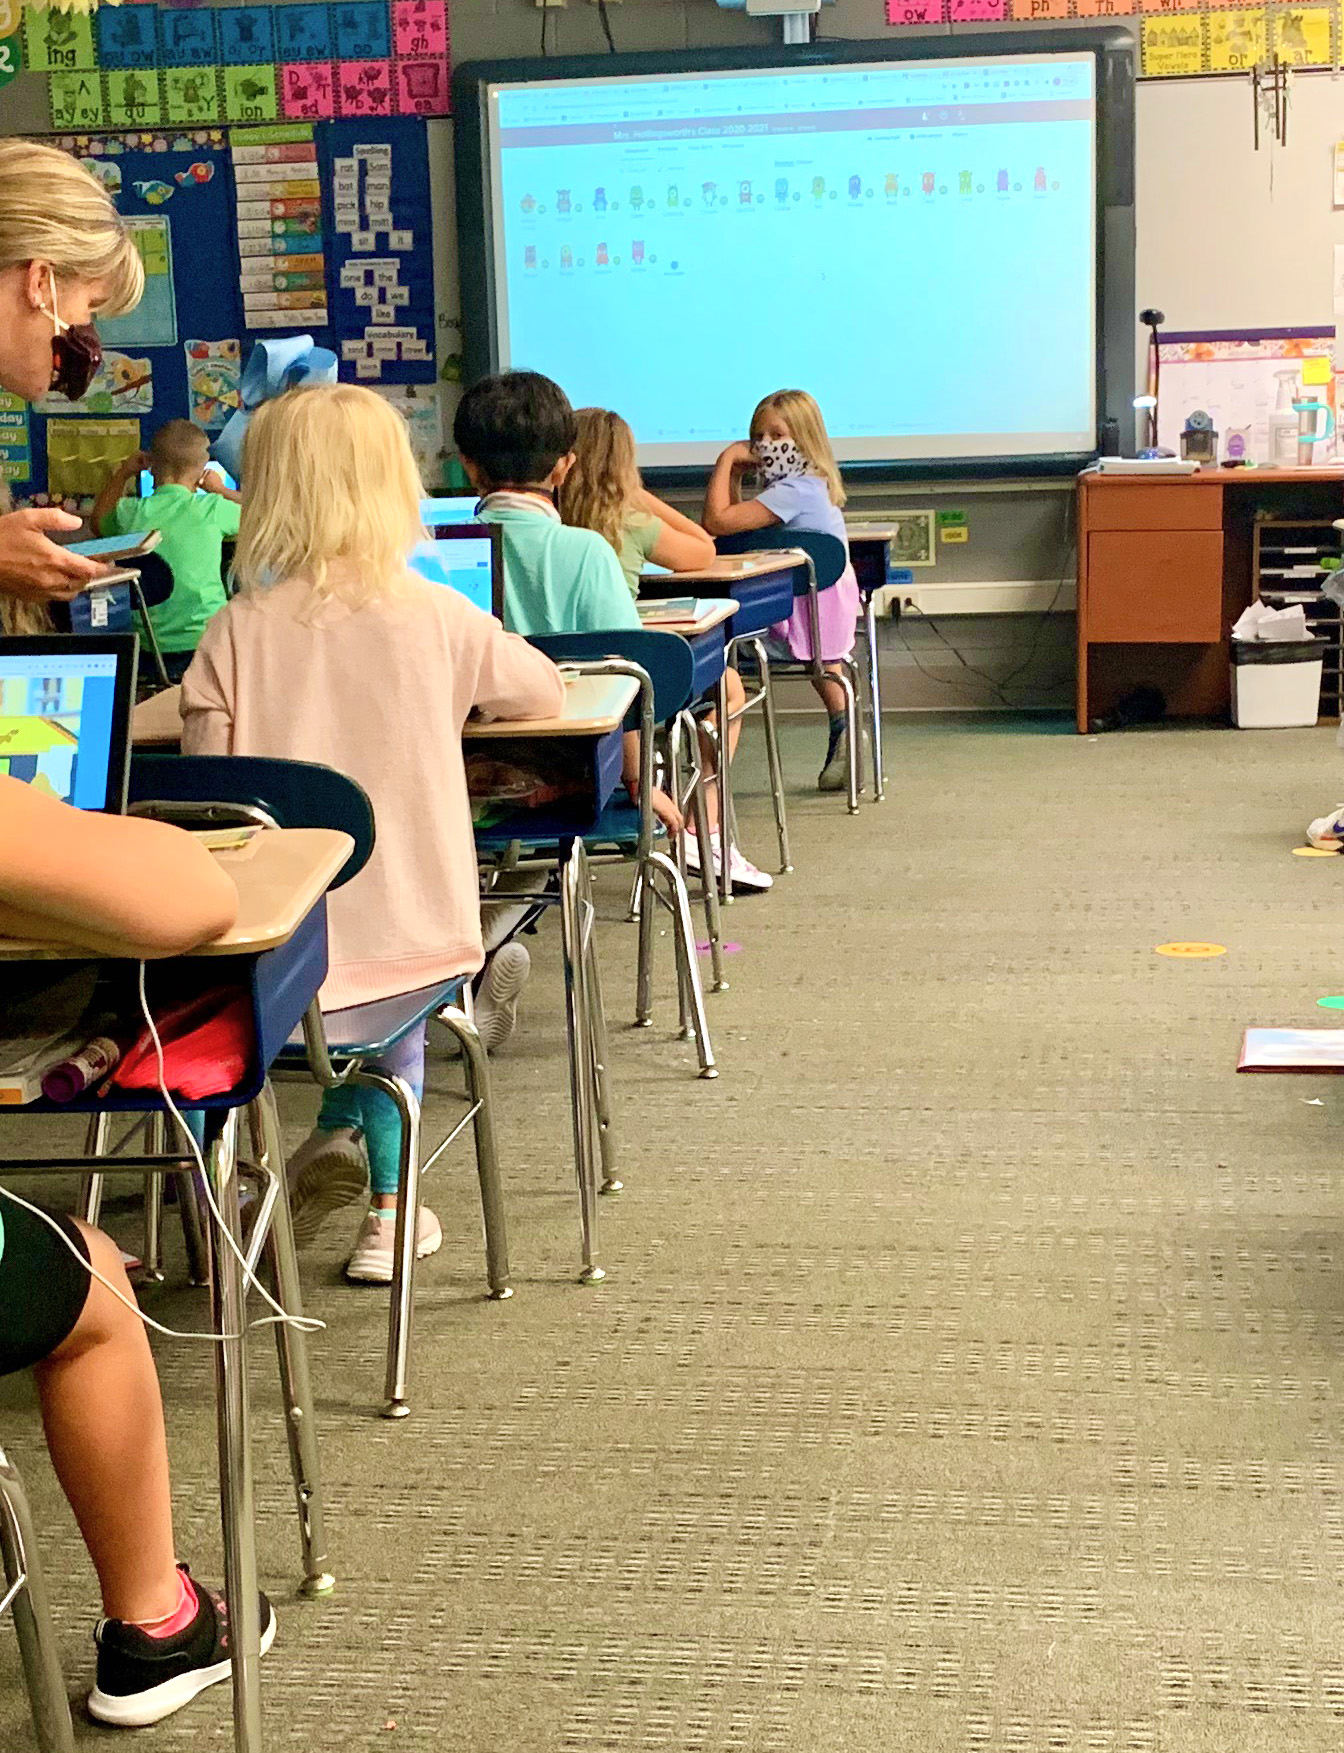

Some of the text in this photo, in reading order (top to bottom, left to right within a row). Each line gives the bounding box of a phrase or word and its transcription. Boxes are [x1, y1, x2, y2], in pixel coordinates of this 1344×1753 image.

[411, 34, 429, 52] gh
[47, 46, 76, 67] ing
[1149, 50, 1173, 61] Super
[1229, 53, 1247, 66] or
[1293, 48, 1312, 61] ar
[240, 103, 263, 117] ion
[301, 99, 319, 114] ed
[55, 108, 99, 123] ay ey
[124, 107, 145, 124] qu
